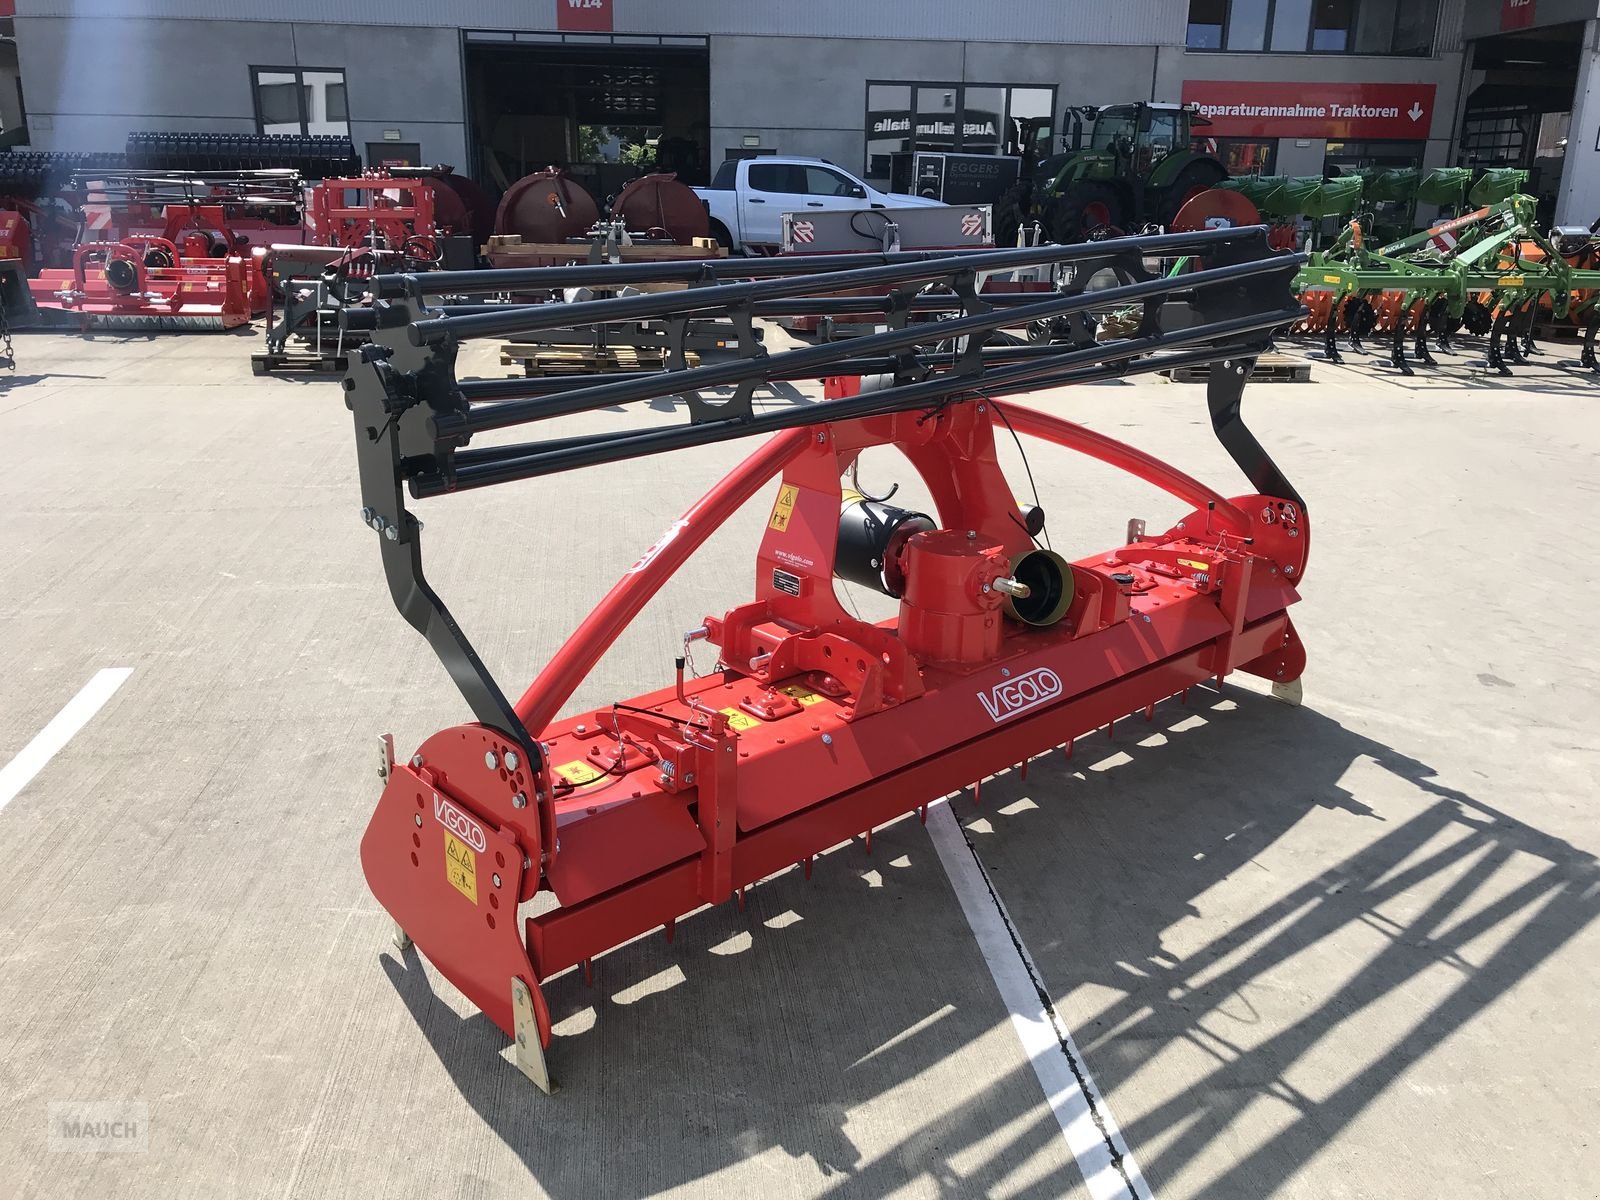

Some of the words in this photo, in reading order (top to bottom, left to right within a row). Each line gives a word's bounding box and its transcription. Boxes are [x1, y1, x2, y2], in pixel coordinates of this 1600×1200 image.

[568, 0, 603, 9] W14
[1191, 101, 1326, 119] Reparaturannahme
[1329, 103, 1399, 118] Traktoren
[951, 162, 1001, 174] EGGERS
[1438, 213, 1480, 232] AMAZONE
[775, 549, 814, 566] www.vigolo.com
[976, 667, 1063, 723] VIGOLO
[433, 792, 486, 853] VIGOLO
